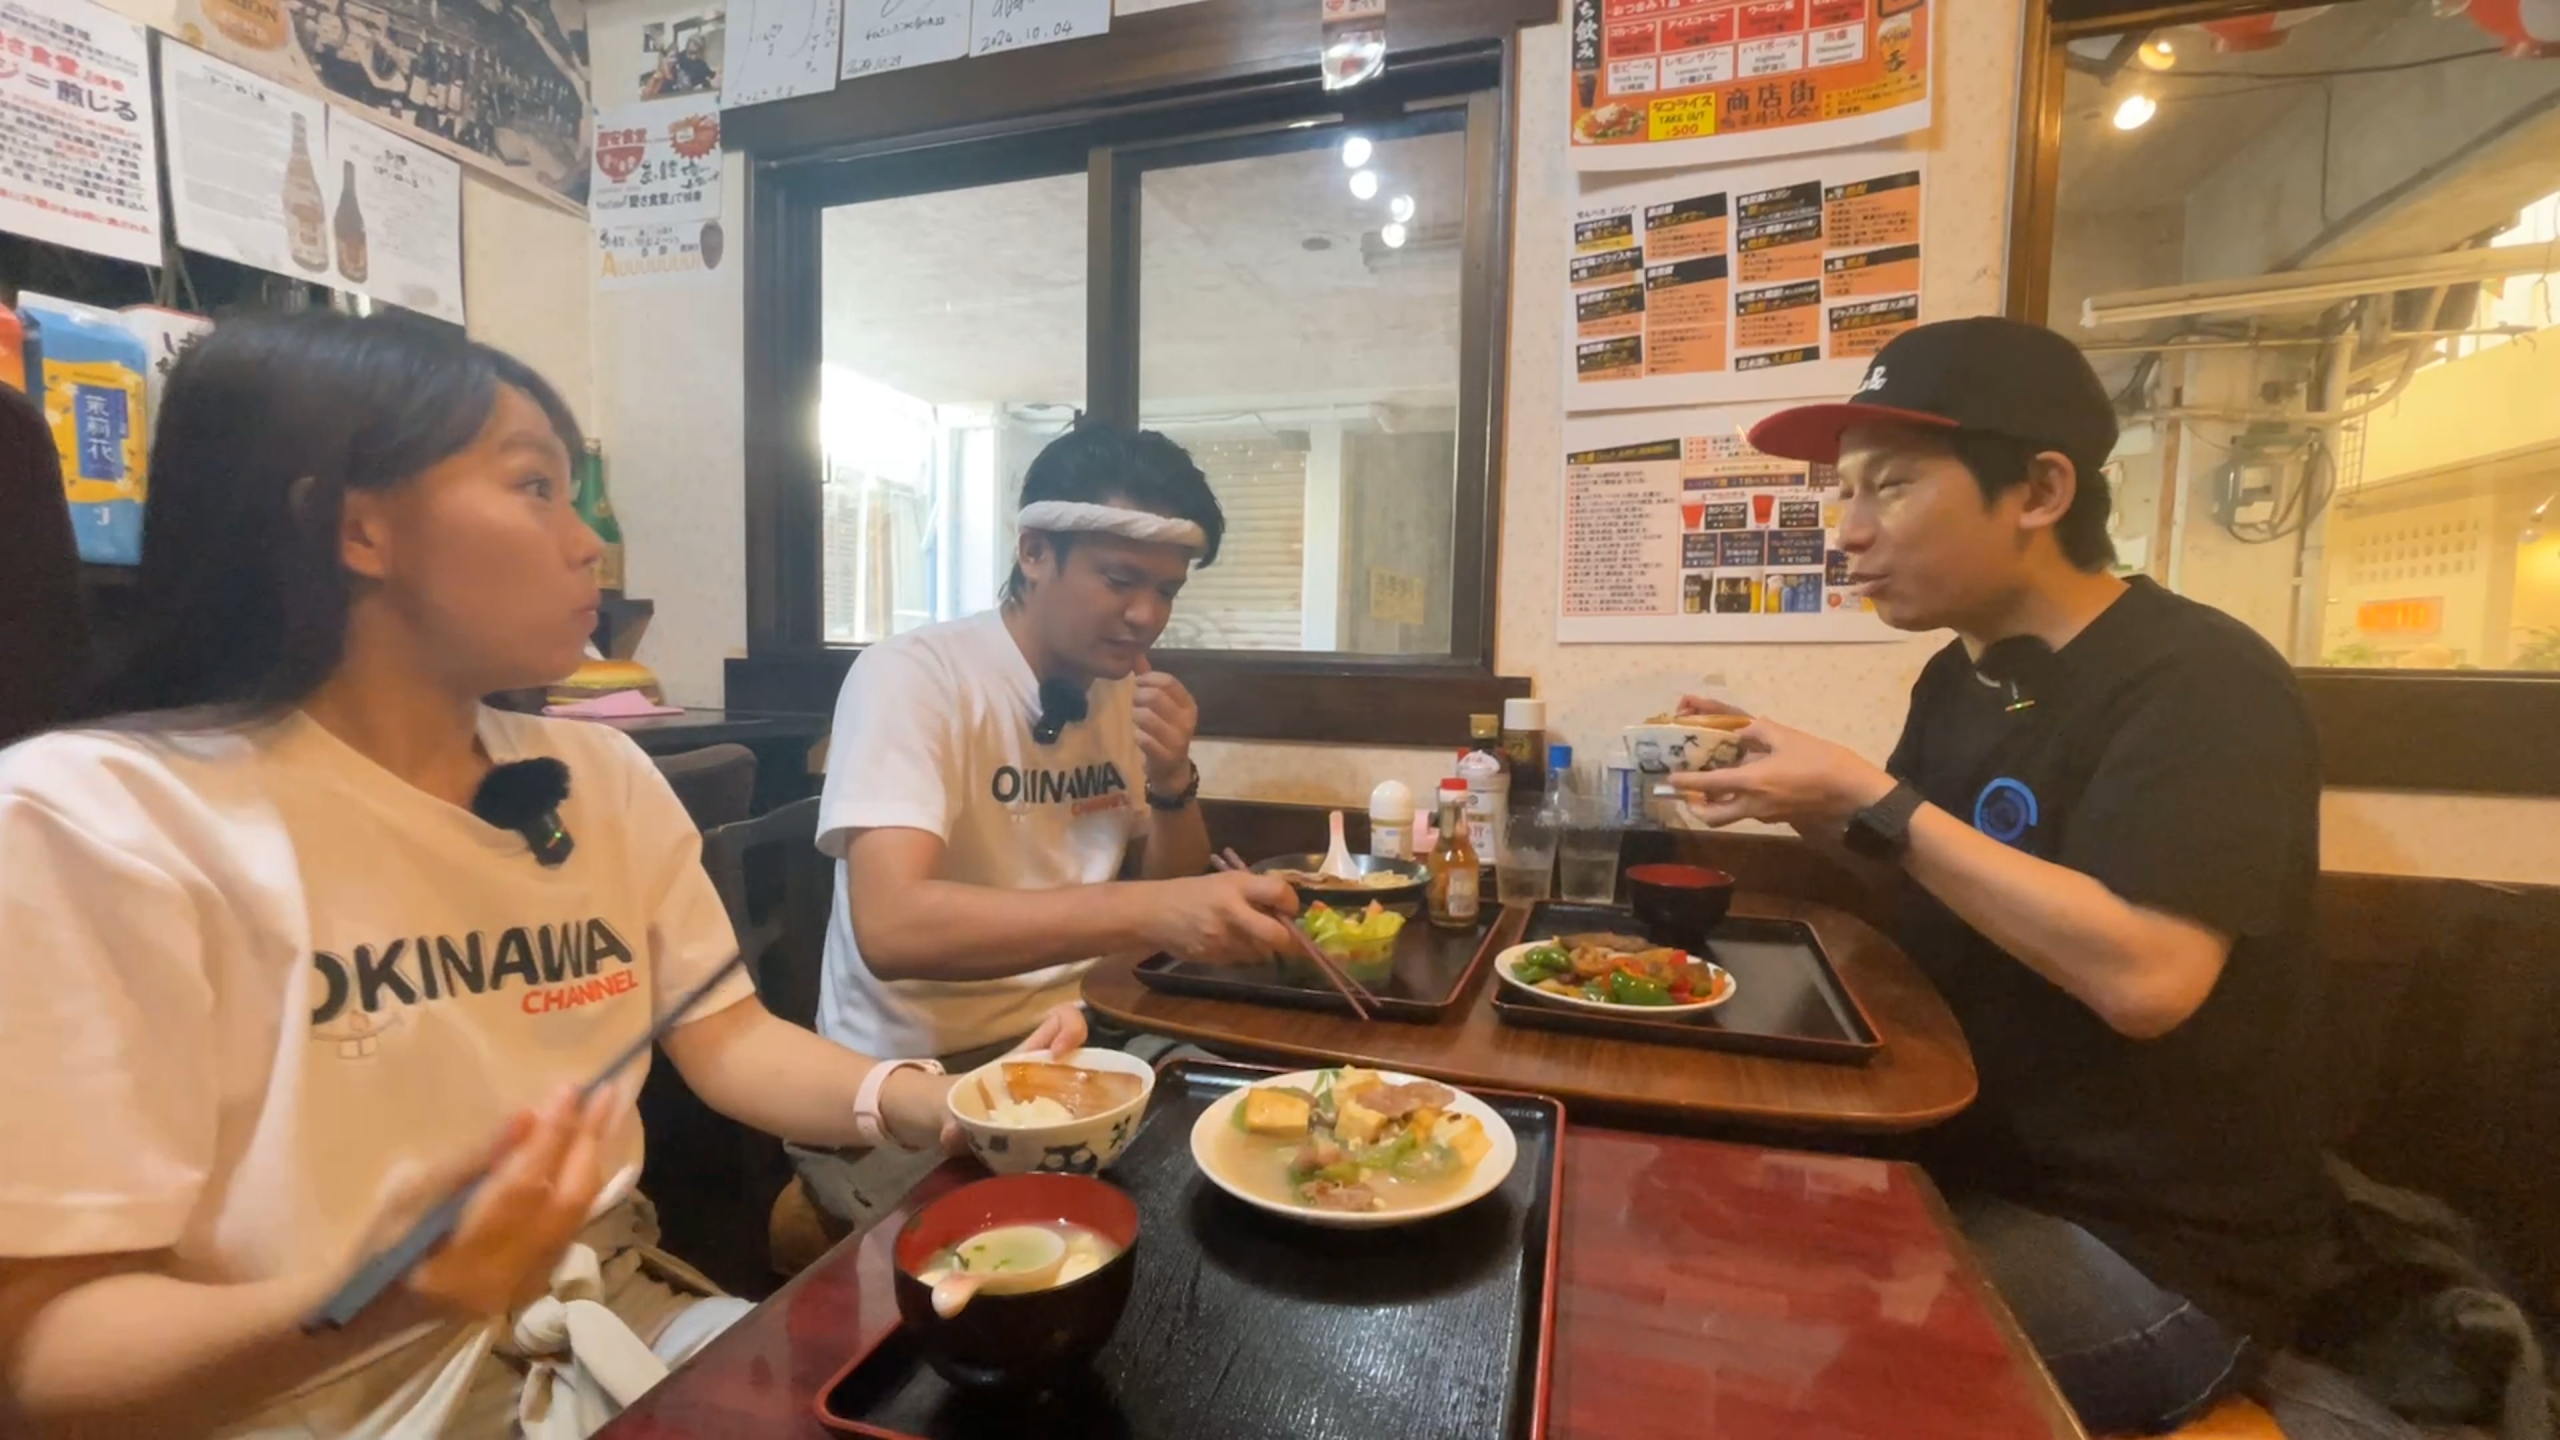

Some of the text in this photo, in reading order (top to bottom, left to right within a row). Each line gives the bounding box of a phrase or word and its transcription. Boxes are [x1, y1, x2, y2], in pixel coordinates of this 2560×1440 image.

[1742, 38, 1799, 54] ハイボール
[1664, 51, 1729, 67] レモンサワー
[1653, 95, 1713, 113] タコライス
[1725, 78, 1817, 114] 商店街
[1659, 114, 1684, 124] TAKE
[521, 969, 639, 1015] CHANNEL
